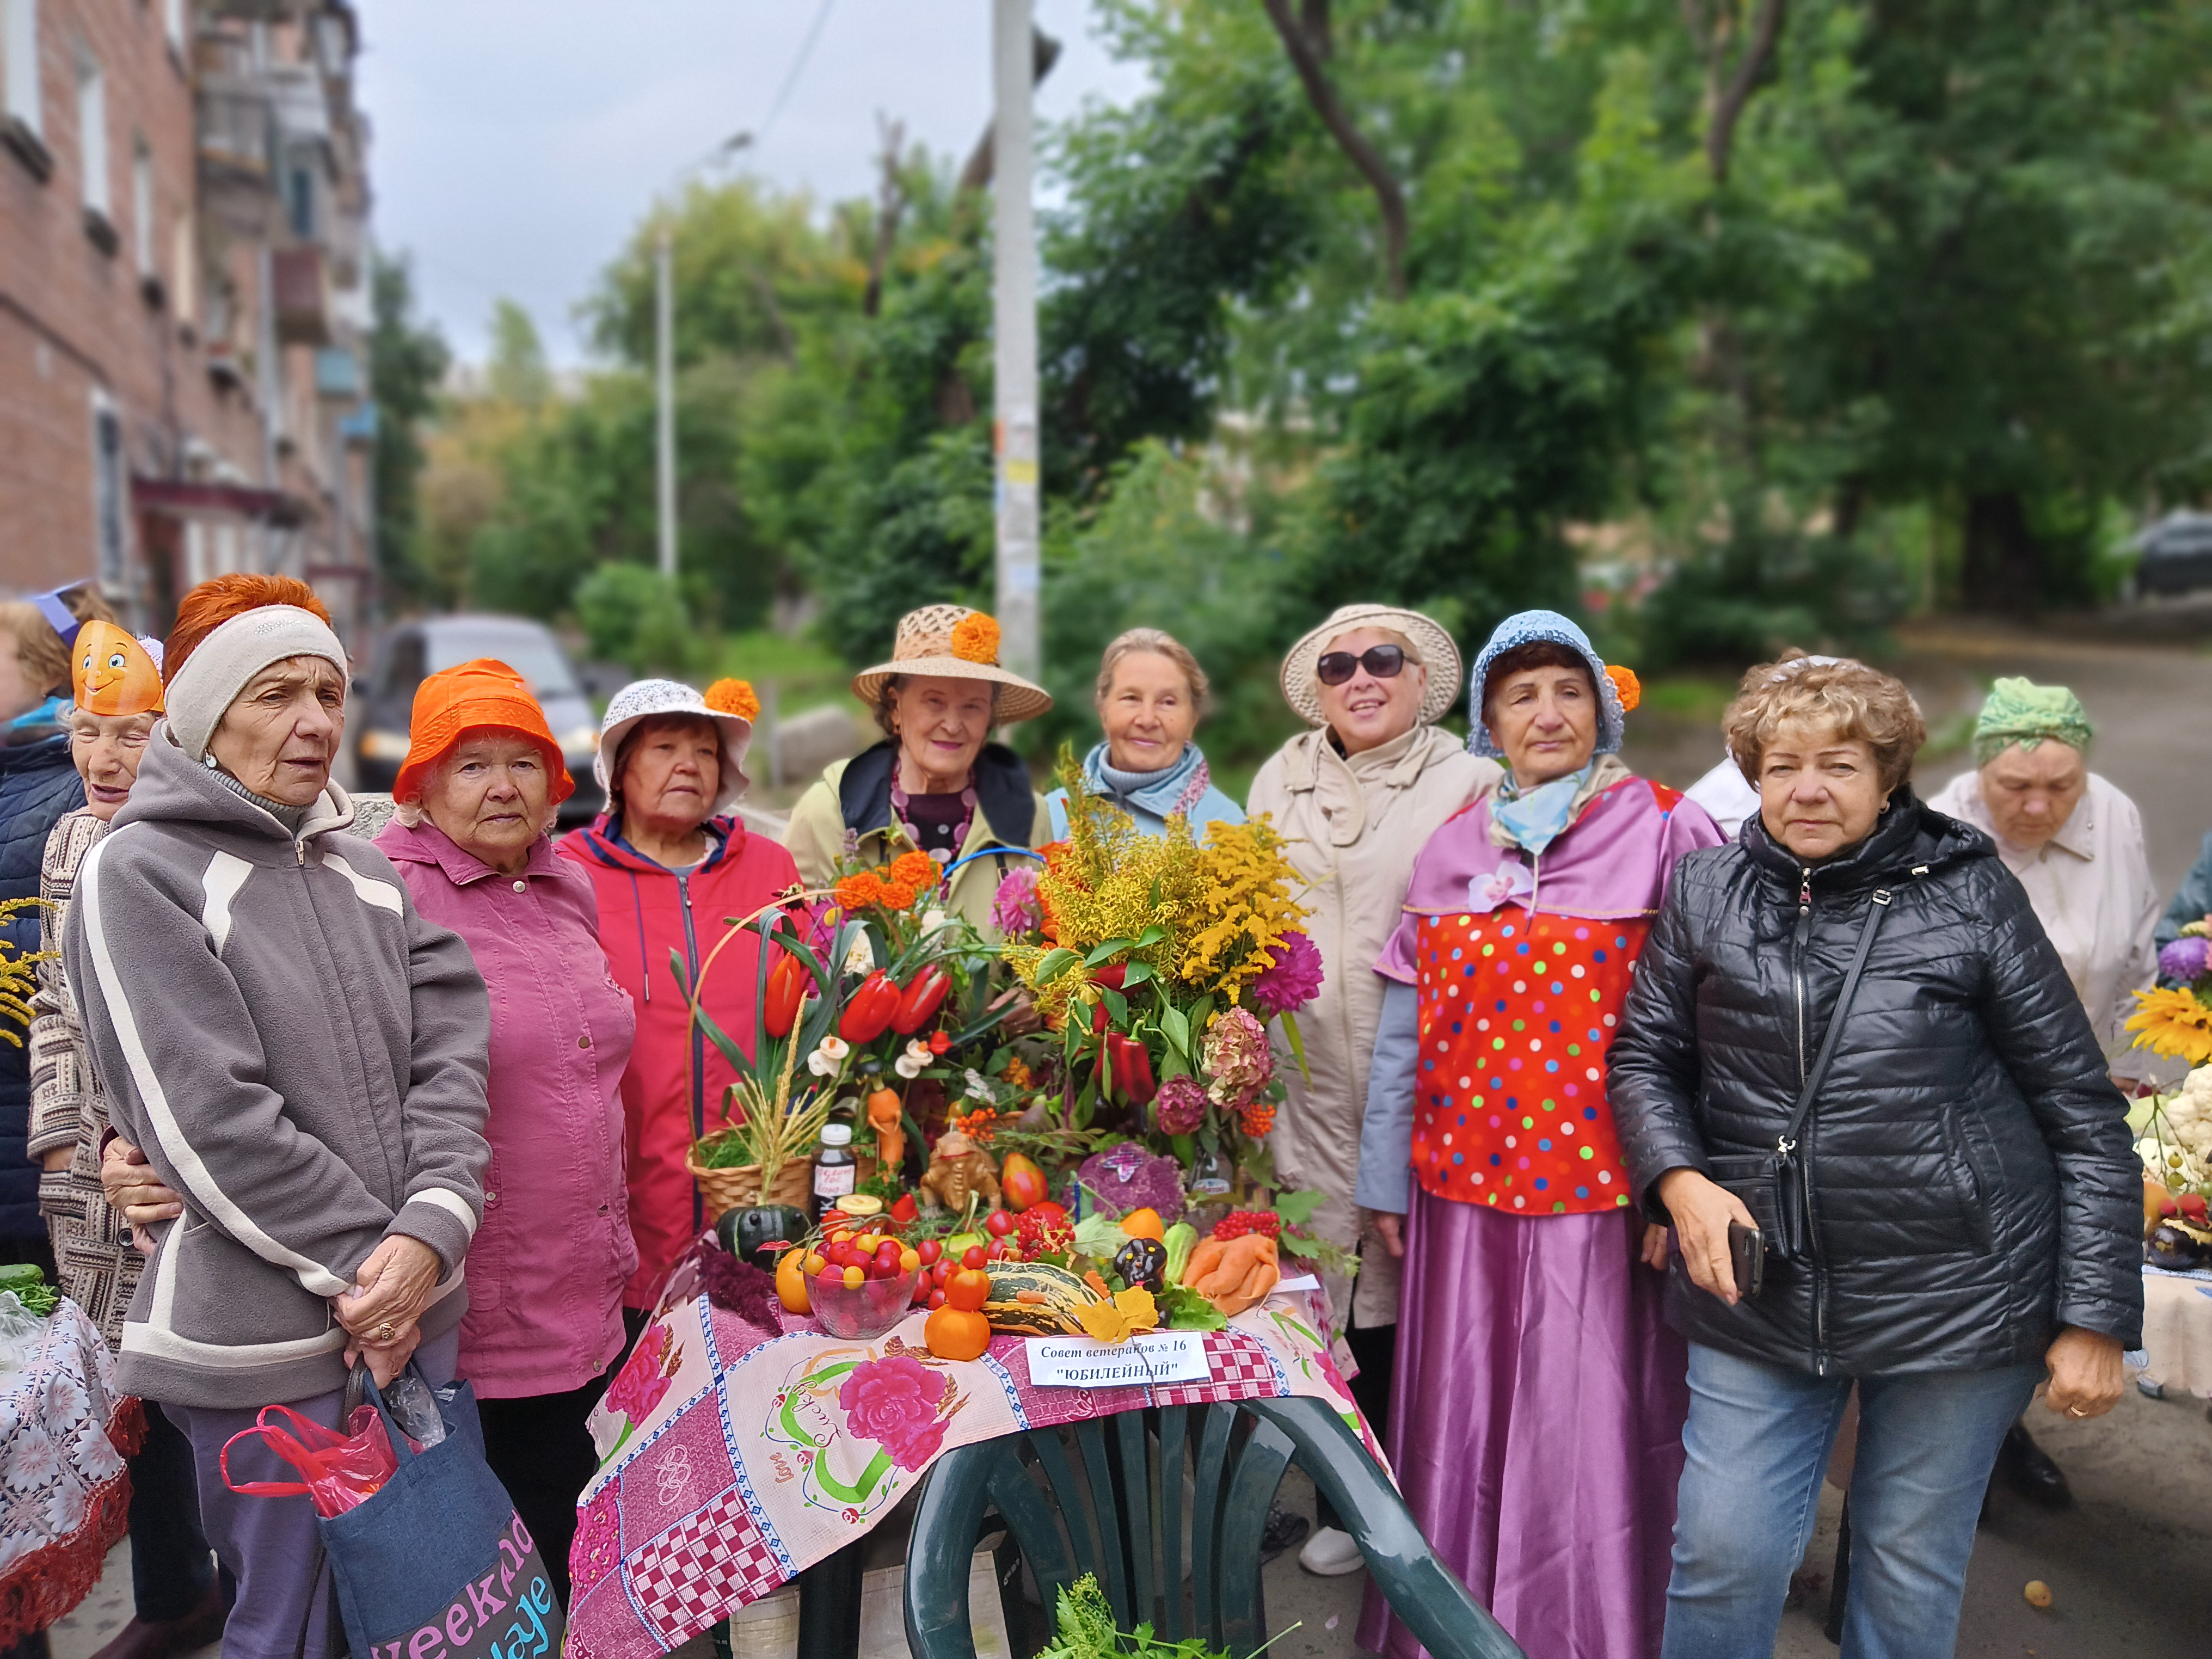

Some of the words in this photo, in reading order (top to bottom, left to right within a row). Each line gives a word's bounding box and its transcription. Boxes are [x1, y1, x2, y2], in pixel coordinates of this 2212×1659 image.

[1041, 1347, 1082, 1358] Совет
[1086, 1344, 1154, 1358] ветеранов
[1158, 1343, 1168, 1352] №
[1172, 1340, 1187, 1351] 16
[1056, 1361, 1178, 1380] "ЮБИЛЕЙНЫЙ"
[792, 1380, 842, 1448] Lucky
[769, 1452, 795, 1484] love
